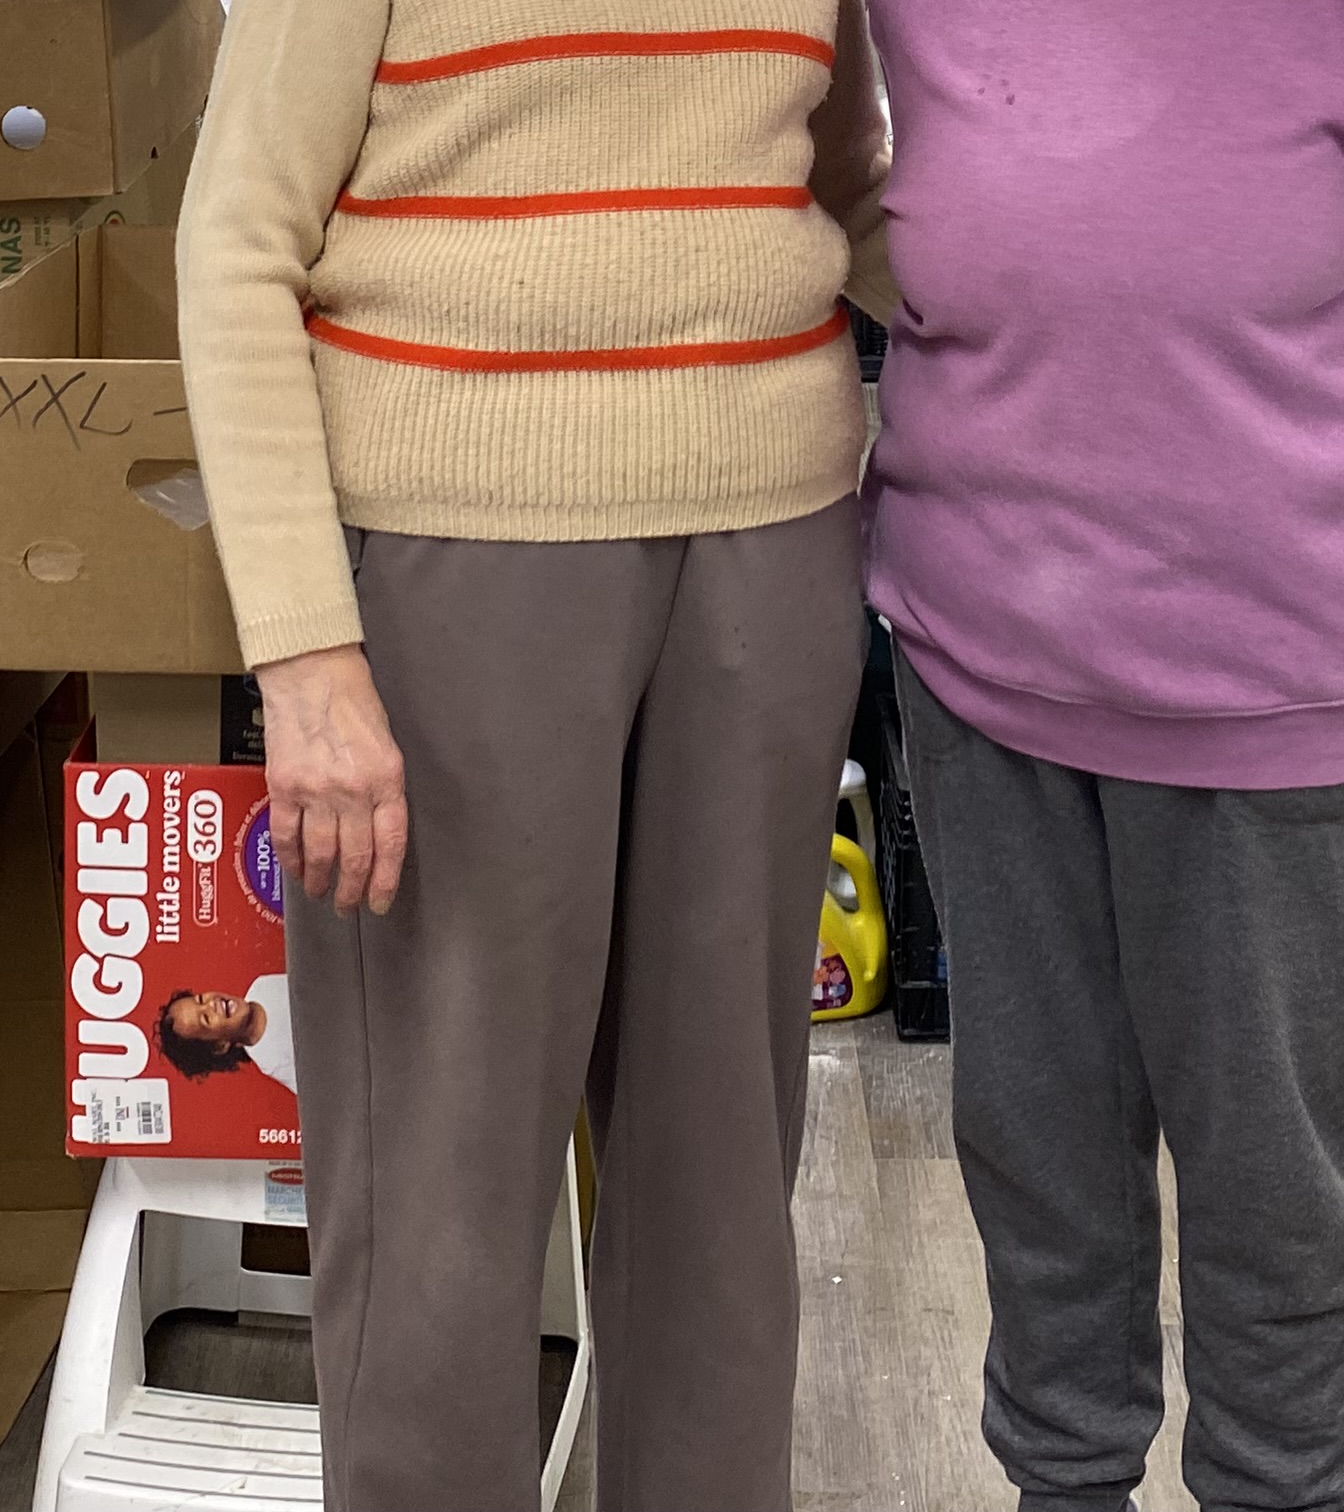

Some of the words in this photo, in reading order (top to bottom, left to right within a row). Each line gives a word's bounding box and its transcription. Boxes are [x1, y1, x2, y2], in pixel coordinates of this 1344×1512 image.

[157, 769, 182, 873] movers
[192, 796, 219, 858] 360
[155, 876, 181, 943] little
[70, 768, 150, 1143] UGGIES
